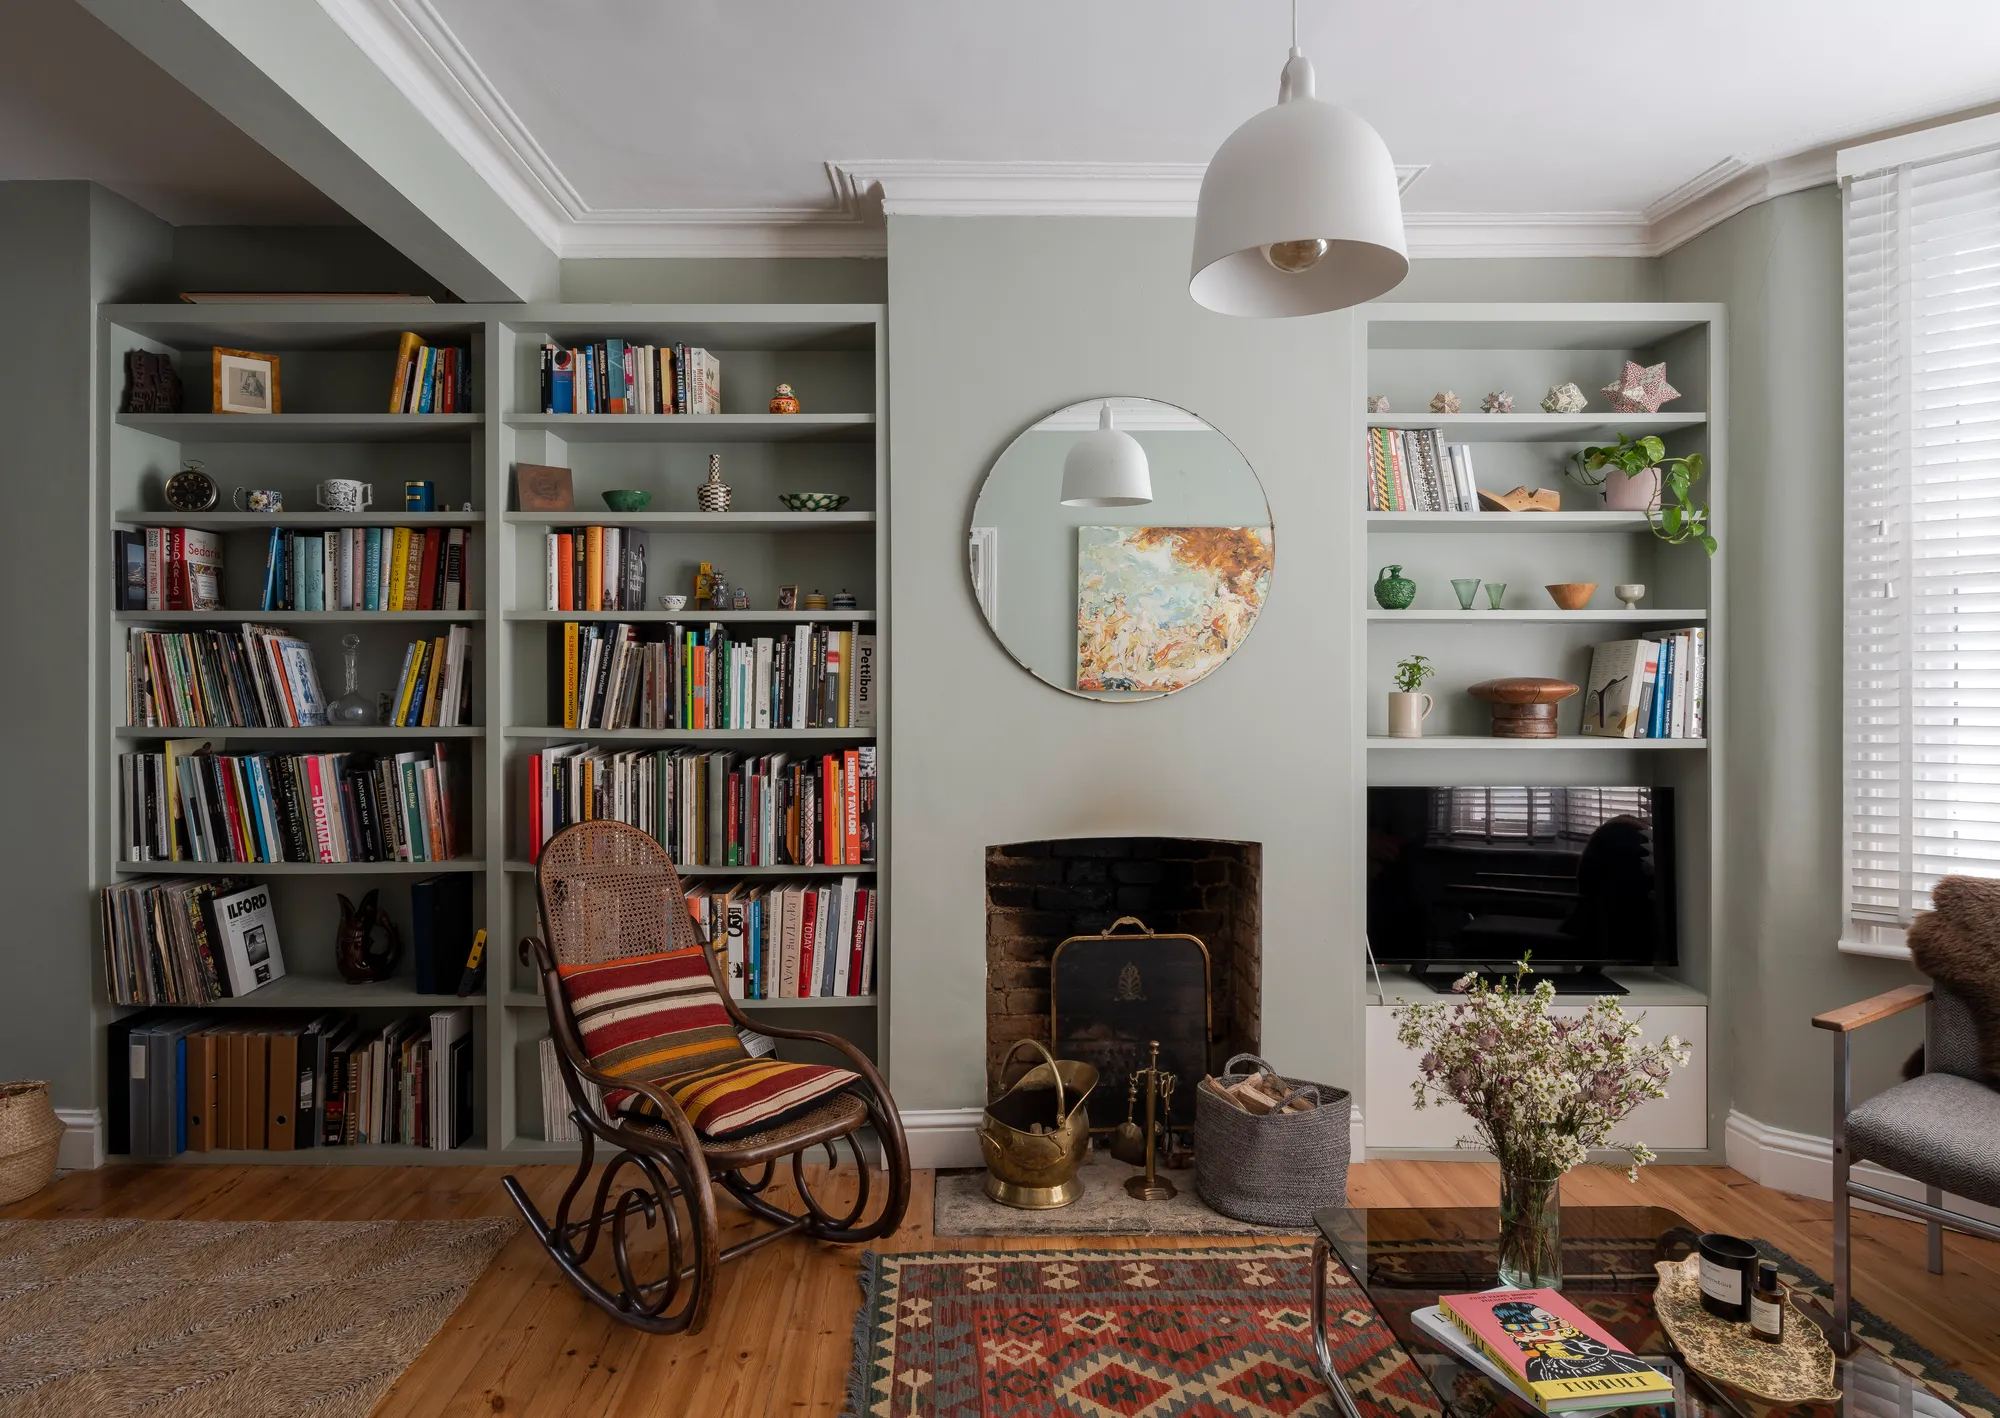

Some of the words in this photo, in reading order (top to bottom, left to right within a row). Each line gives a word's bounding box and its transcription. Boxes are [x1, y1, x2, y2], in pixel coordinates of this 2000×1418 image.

[696, 368, 704, 404] Middlesex
[396, 530, 404, 562] ZADIE
[410, 536, 418, 562] HERE
[589, 530, 597, 552] GRACE
[173, 534, 181, 596] SEDARIS
[150, 572, 158, 594] FINDING
[392, 570, 400, 602] SMITH
[408, 572, 414, 588] AM
[602, 644, 611, 670] Charlotte
[598, 671, 606, 695] Perriand
[860, 648, 872, 702] Pettibon
[1694, 656, 1706, 696] Design
[280, 758, 288, 778] LOVE
[406, 770, 414, 792] William
[848, 757, 856, 793] HENRY
[357, 778, 366, 809] FANTASTIC
[408, 792, 416, 808] Blake
[360, 810, 370, 825] MAN
[378, 782, 388, 815] WILLIAM
[383, 818, 394, 848] MORRIS
[848, 794, 857, 836] TAYLOR
[227, 893, 267, 920] ILFORD
[806, 900, 814, 920] USA
[716, 918, 724, 948] Auerbach
[803, 922, 813, 950] TODAY
[854, 920, 864, 951] Basquiat
[1448, 1307, 1486, 1352] TUMULT
[1557, 1375, 1650, 1393] TUMULT
